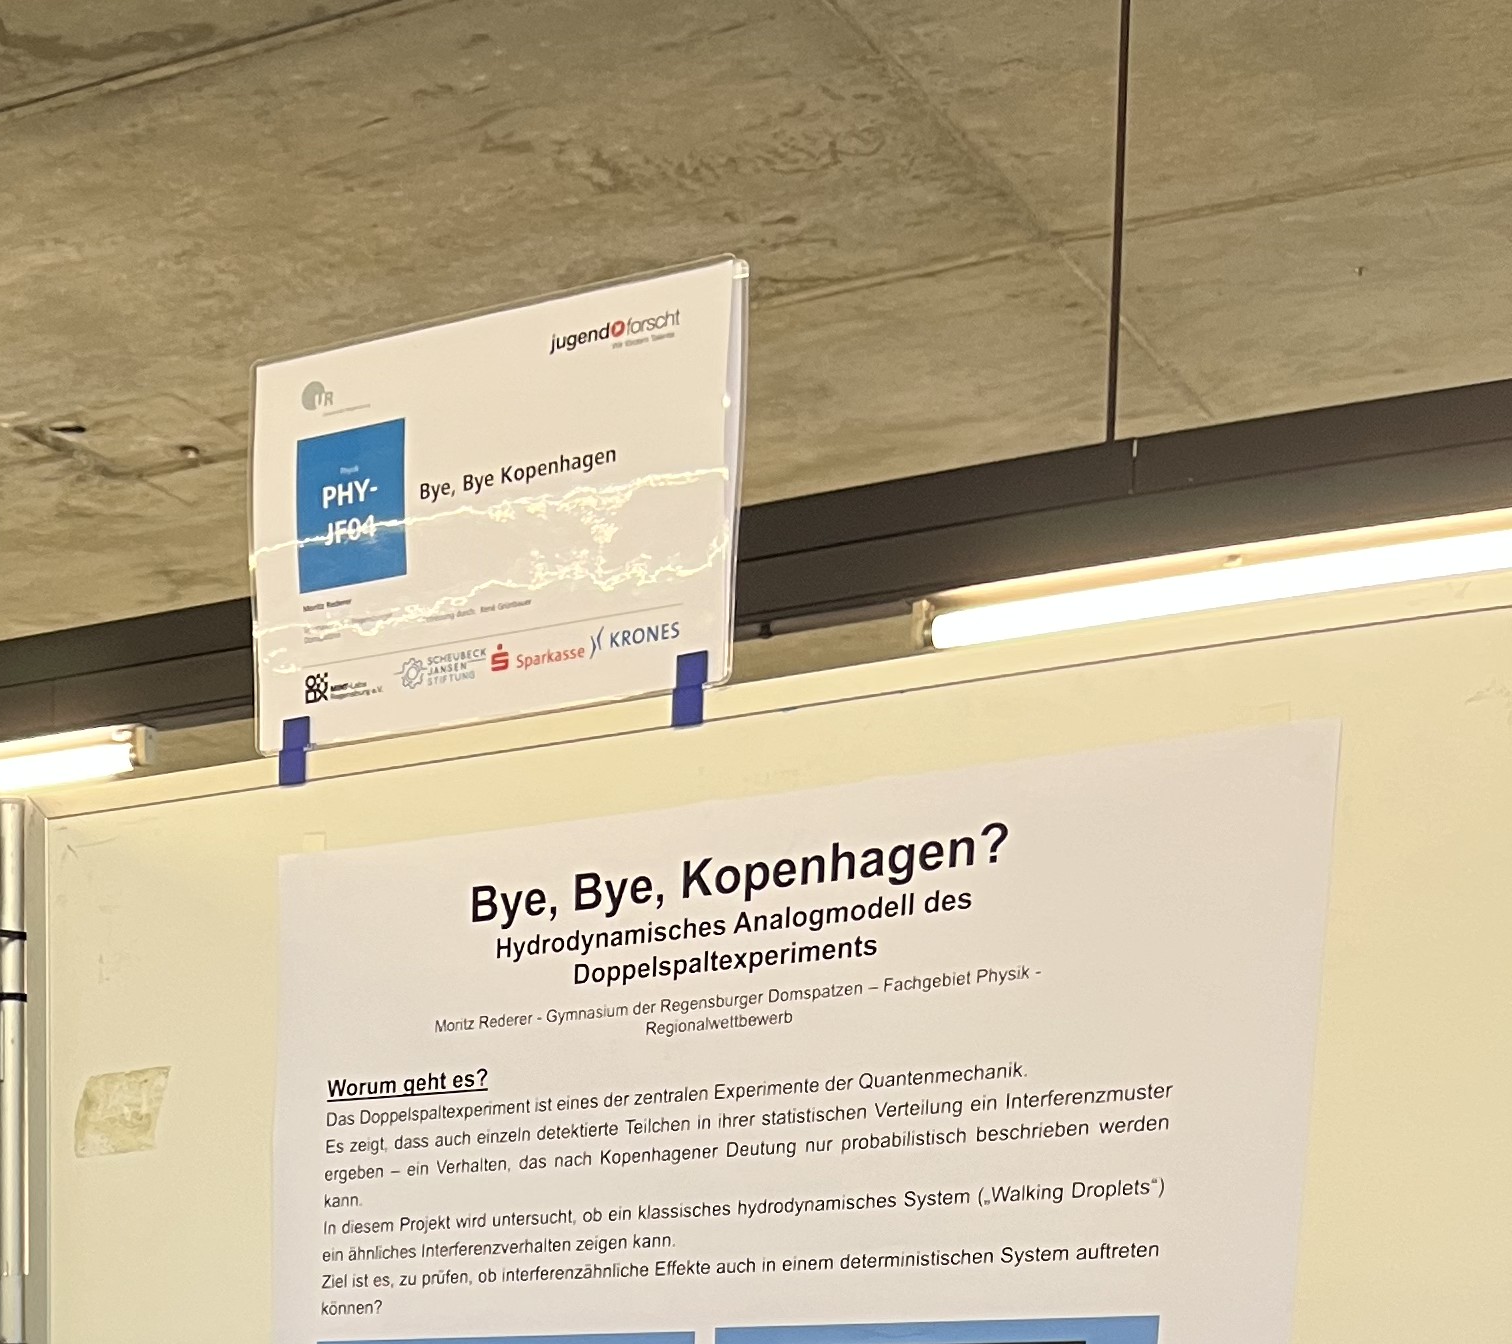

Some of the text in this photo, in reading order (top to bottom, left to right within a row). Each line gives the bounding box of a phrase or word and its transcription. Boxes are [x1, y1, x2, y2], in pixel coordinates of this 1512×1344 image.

[419, 448, 617, 503] Bye, Bye Kopenhagen
[322, 478, 379, 510] PHY-
[324, 514, 376, 546] JF04
[609, 621, 681, 649] KRONES
[427, 647, 487, 666] SCHEUBECK
[427, 662, 468, 676] JANSEN
[516, 646, 586, 670] Sparkasse
[427, 670, 476, 686] STIFTUNG
[472, 822, 1008, 930] Bye, Bye, Kopenhagen?
[497, 890, 972, 962] Hydrodynamisches Analogmodell des
[574, 936, 877, 987] Doppelspaltexperiments
[434, 964, 1031, 1033] Moritz Rederer Gymnasium der Regensburger Domspatzen Fachgebiet Physik
[645, 1009, 793, 1038] Regionalwettbewerb
[326, 1061, 1028, 1127] Das Doppelspaltexperiment ist eines der zentralen Experimente der Quantenmechanik.
[327, 1068, 489, 1098] Worum geht es?
[325, 1083, 1174, 1156] Es zeigt, dass auch einzeln detektierte Teilchen in ihrer statistischen Verteilung ein Interferenzmuster
